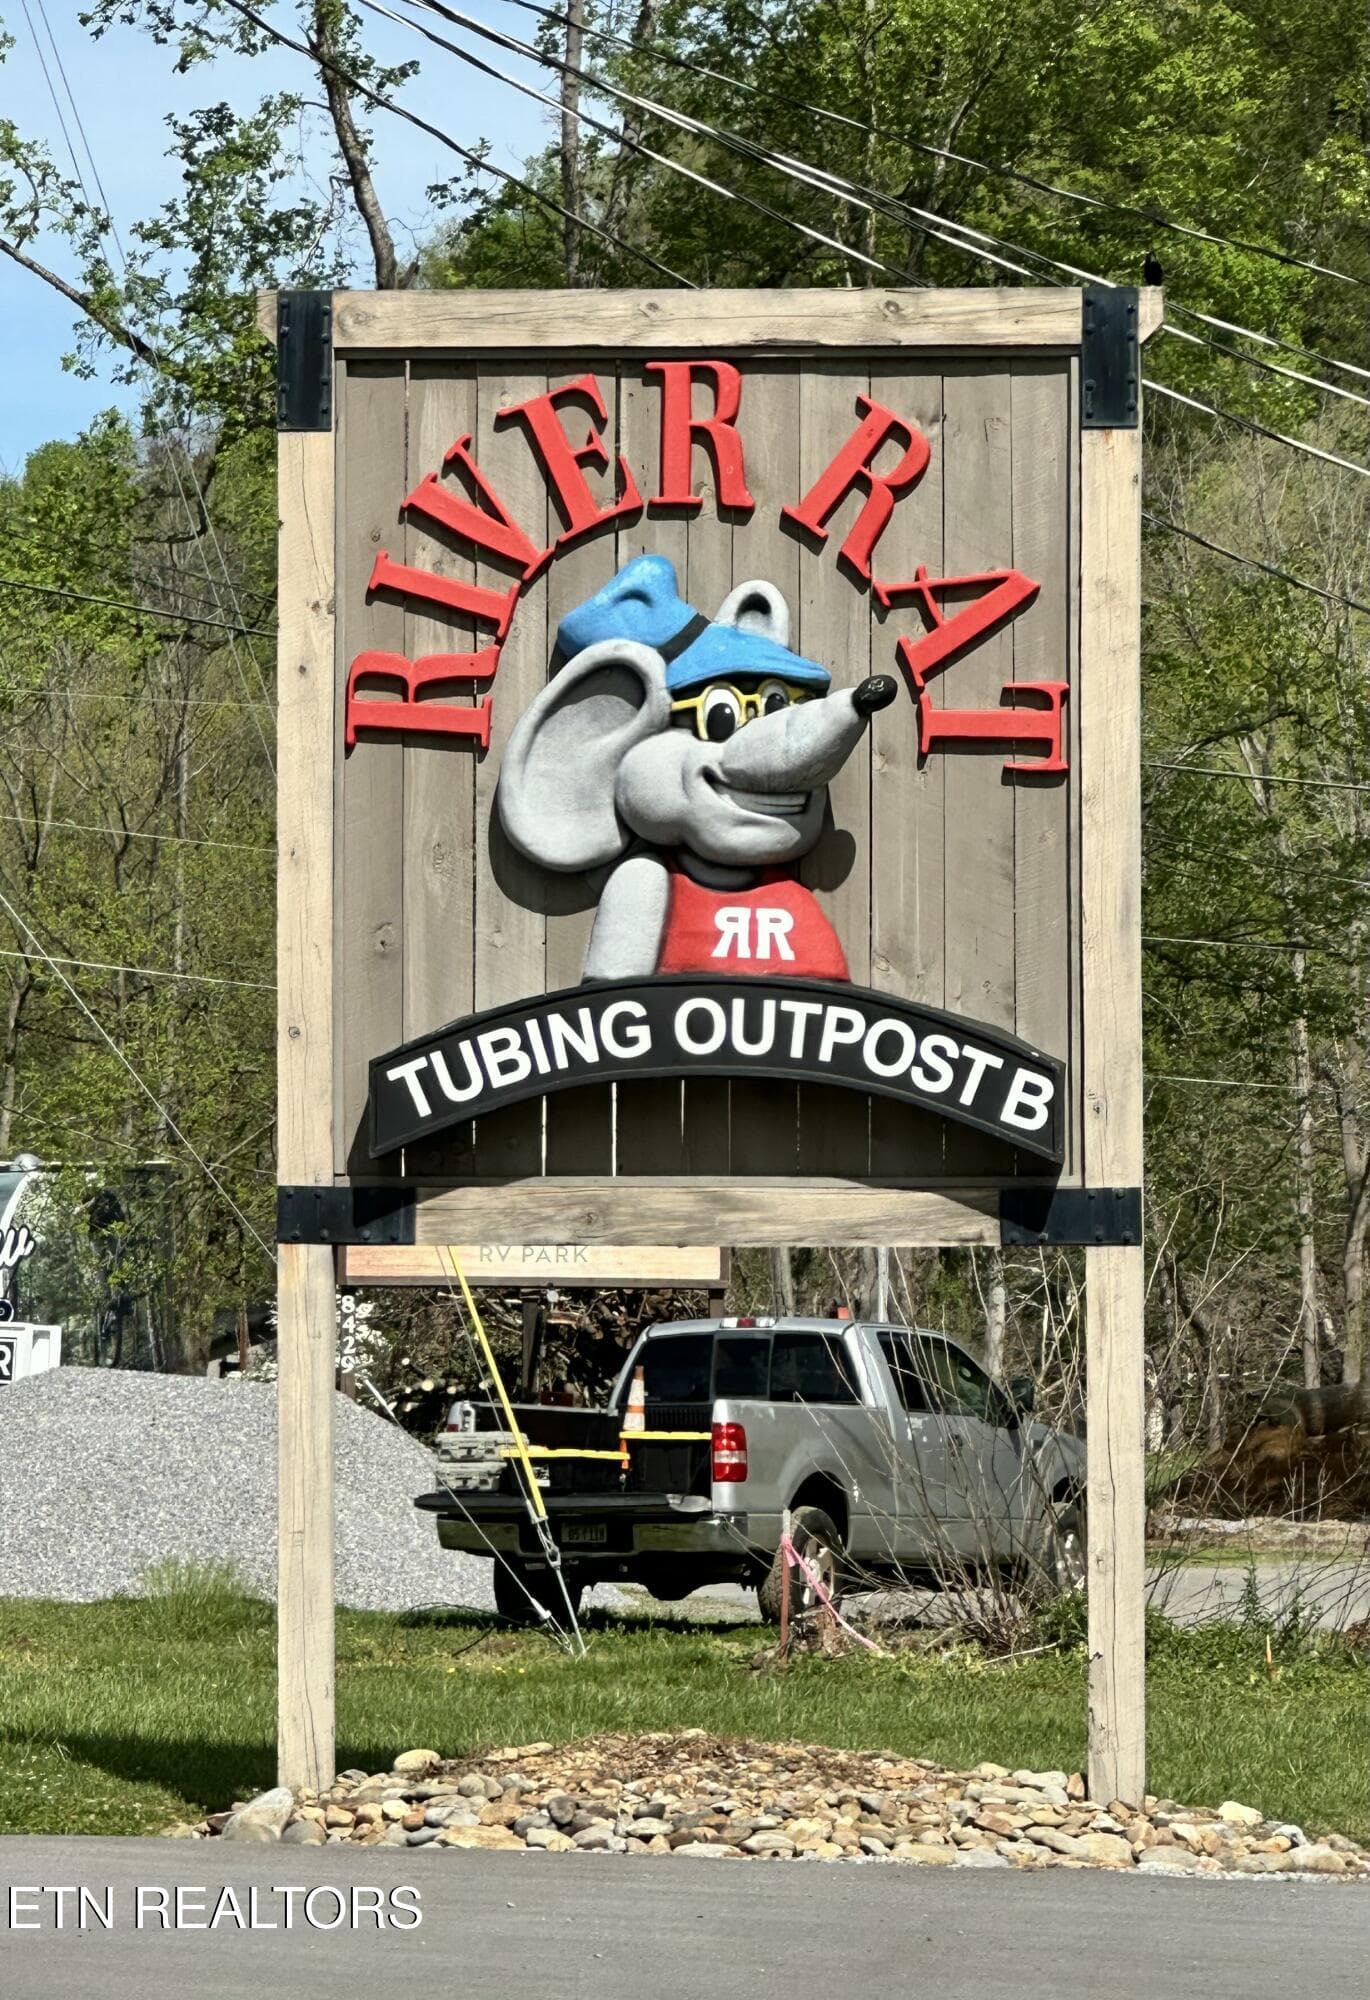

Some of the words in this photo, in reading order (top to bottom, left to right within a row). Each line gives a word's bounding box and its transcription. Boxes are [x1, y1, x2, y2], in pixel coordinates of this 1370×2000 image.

[346, 360, 756, 750] RIVER
[780, 393, 1071, 772] RAT
[386, 1001, 652, 1118] TUBING
[673, 997, 1004, 1107] OUTPOST
[1001, 1068, 1056, 1132] B
[480, 1244, 511, 1262] RV
[522, 1244, 588, 1263] PARK
[341, 1294, 357, 1374] 8429
